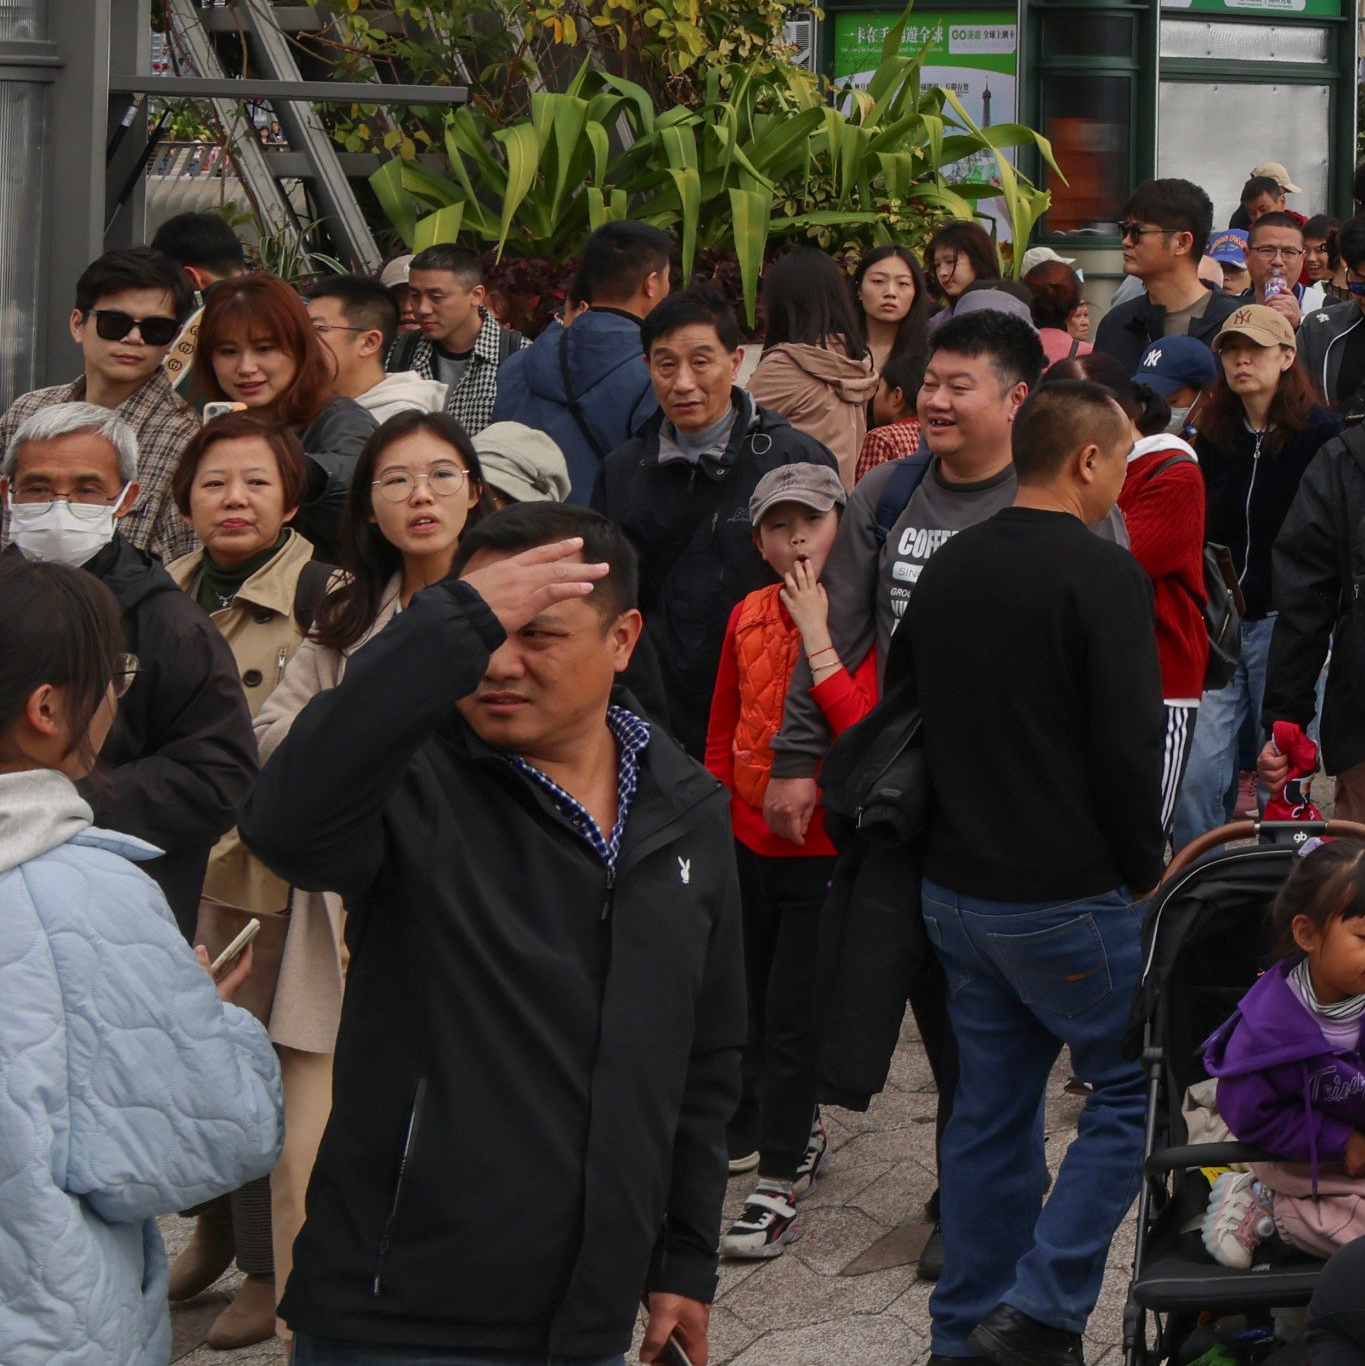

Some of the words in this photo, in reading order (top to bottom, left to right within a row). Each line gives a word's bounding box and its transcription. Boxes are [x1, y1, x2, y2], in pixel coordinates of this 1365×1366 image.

[1234, 310, 1252, 325] NY
[1143, 349, 1162, 367] NY
[1293, 831, 1308, 844] gb
